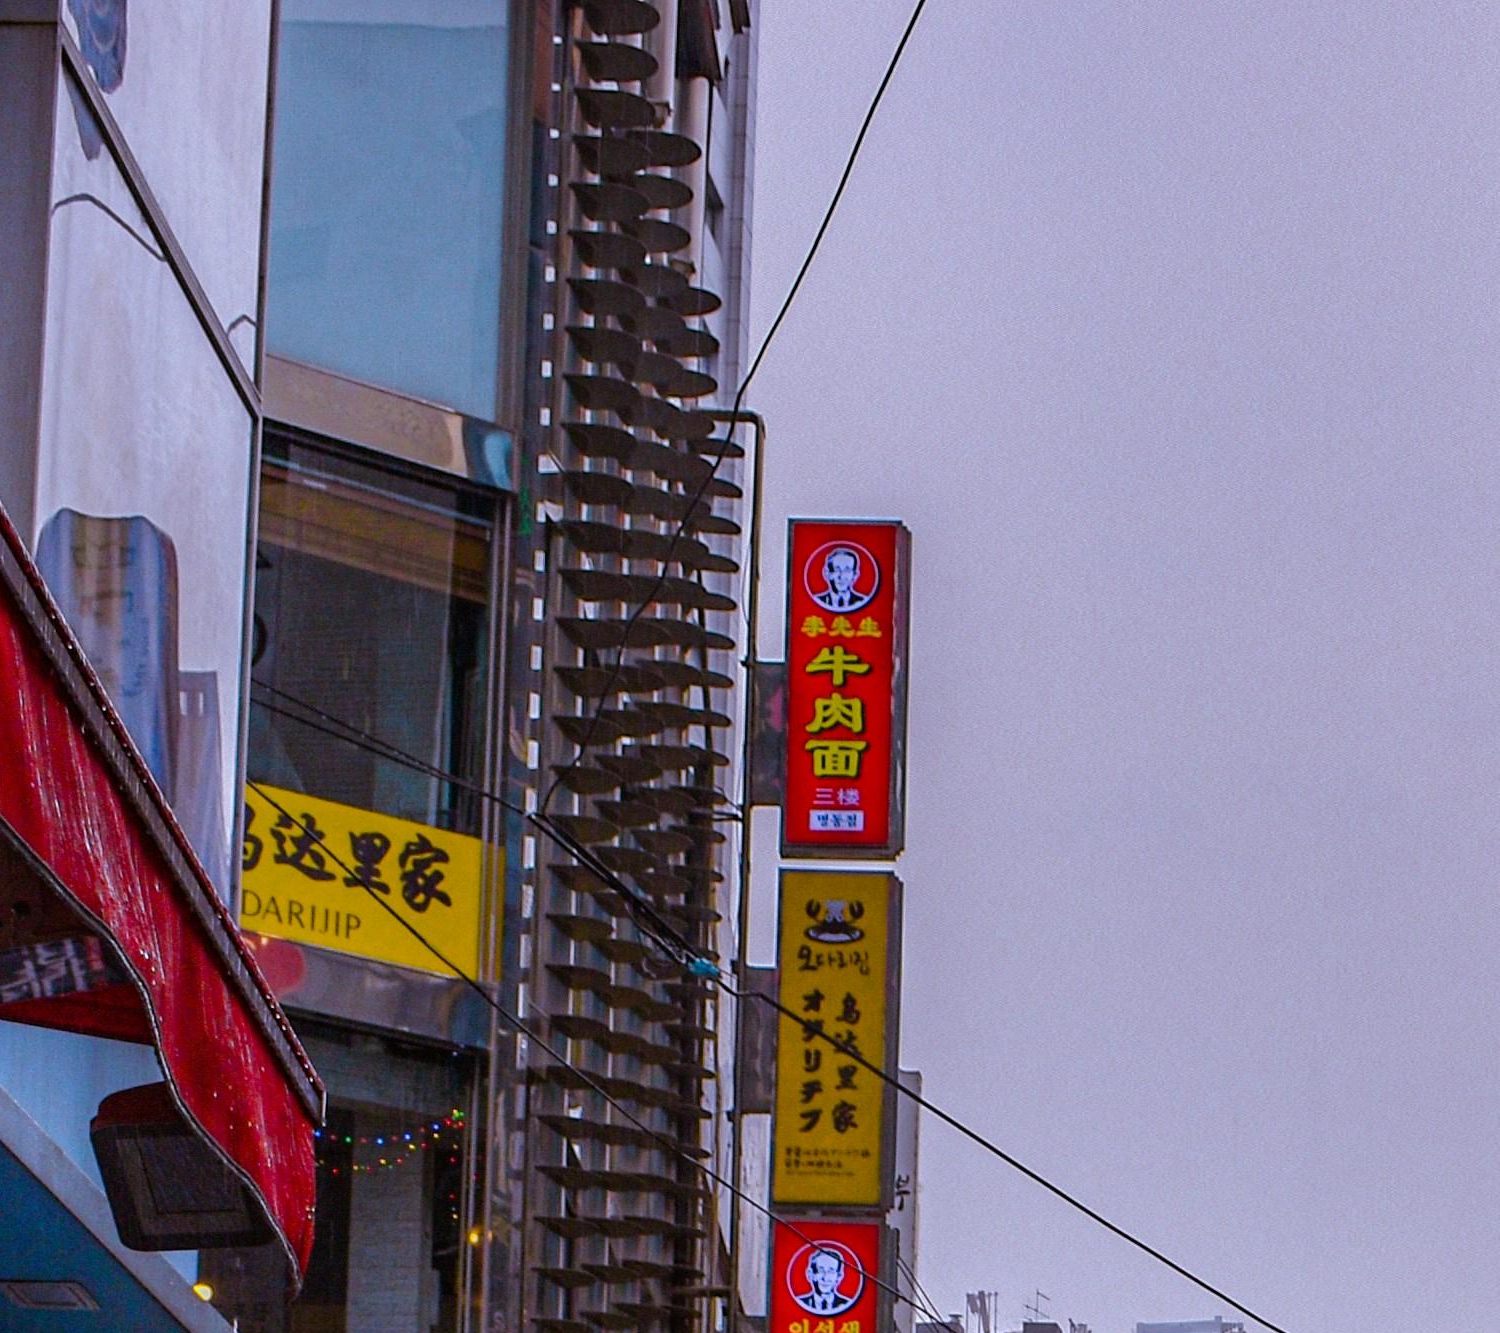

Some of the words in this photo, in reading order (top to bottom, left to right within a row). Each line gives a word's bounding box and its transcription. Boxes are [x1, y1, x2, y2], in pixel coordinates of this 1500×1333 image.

[802, 616, 882, 638] 李先生
[805, 646, 871, 779] 牛肉面
